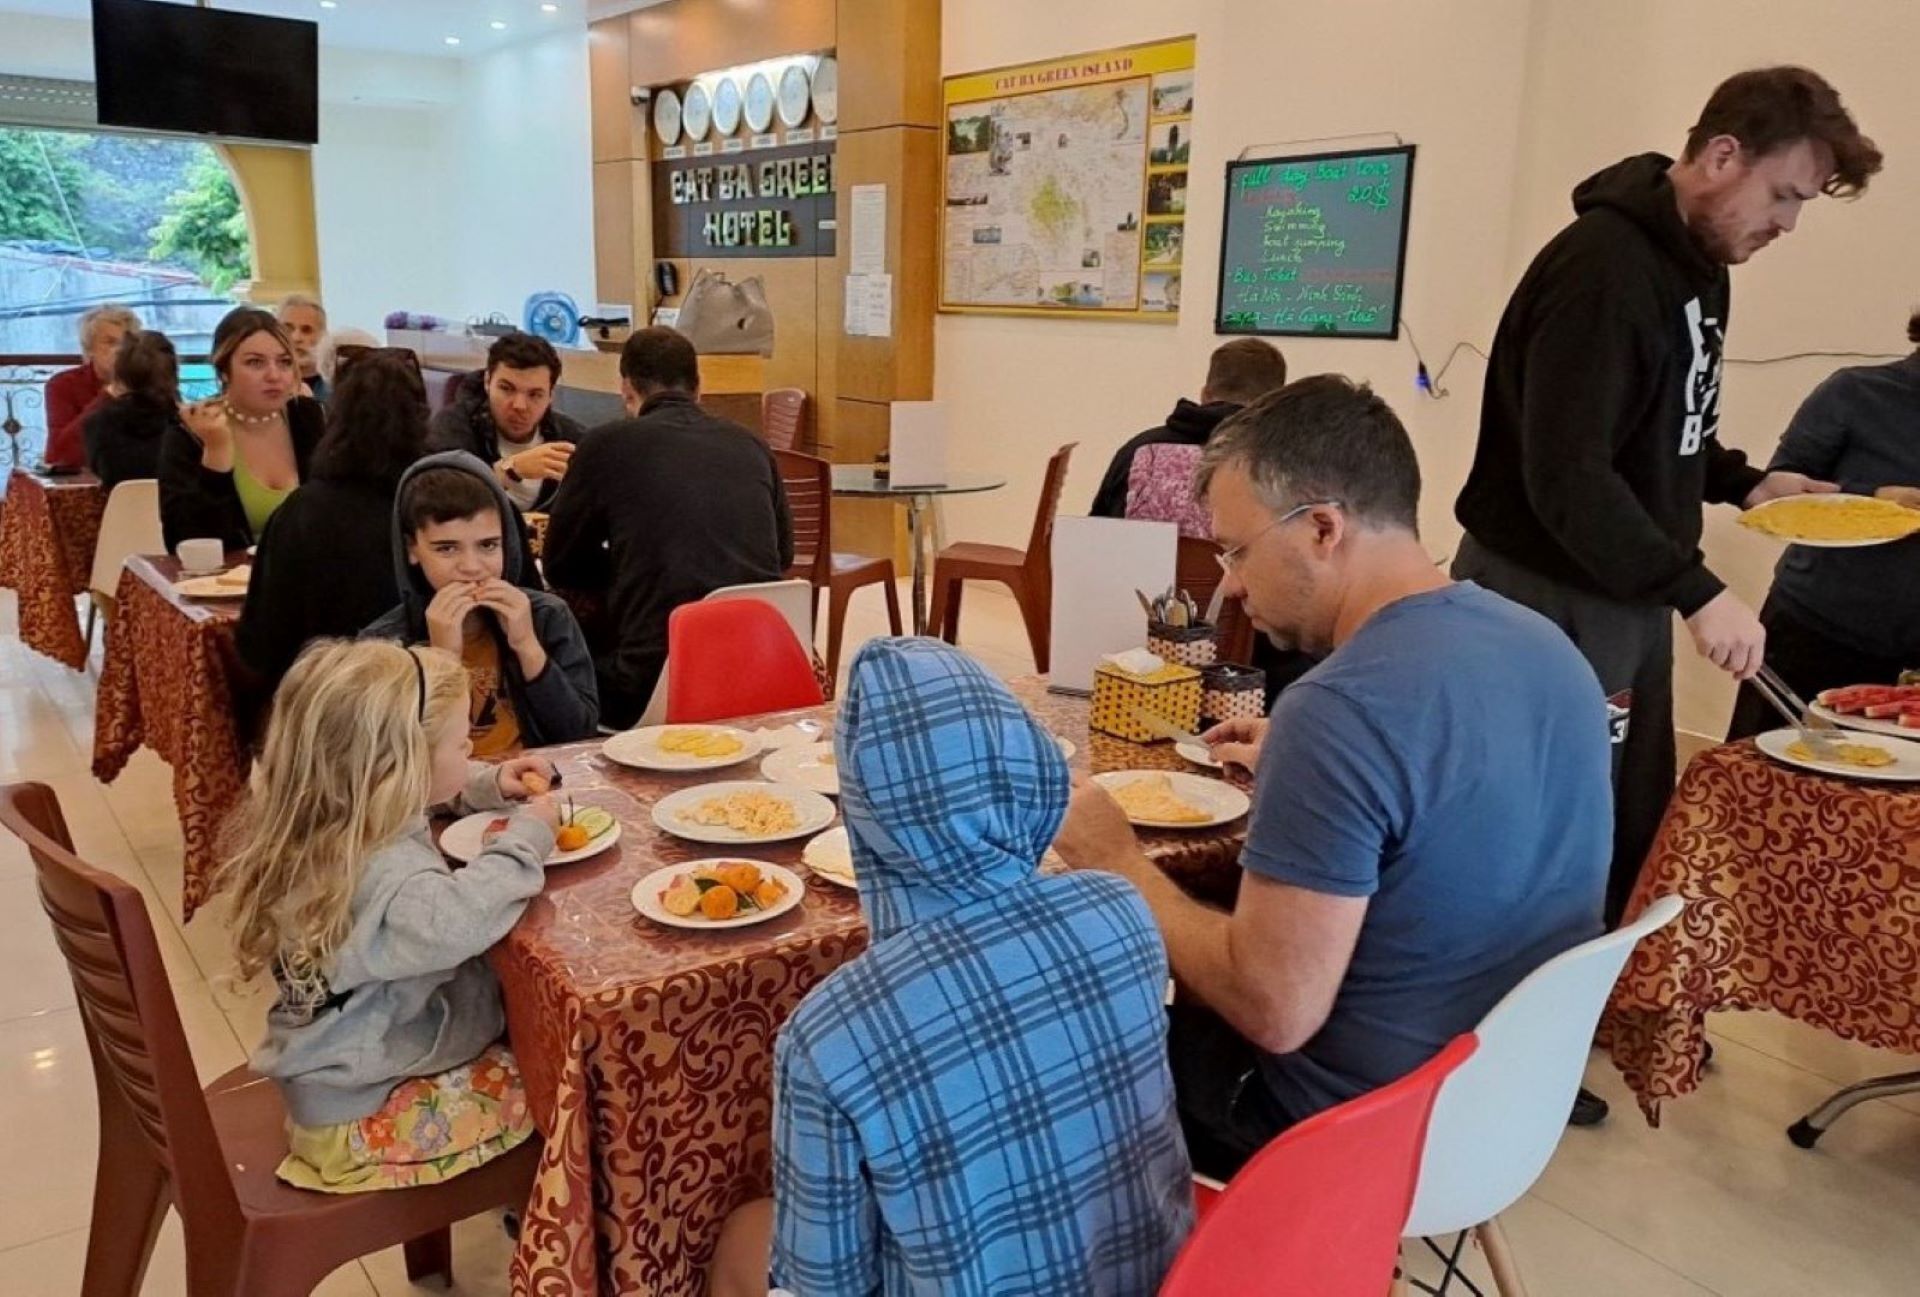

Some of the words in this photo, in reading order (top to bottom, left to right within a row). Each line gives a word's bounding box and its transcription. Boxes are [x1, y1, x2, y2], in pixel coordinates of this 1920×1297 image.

[995, 77, 1015, 90] CAT
[1019, 73, 1035, 86] BA
[1038, 67, 1077, 84] GREEN
[1082, 58, 1133, 77] ISLAND
[719, 164, 754, 200] BA
[703, 210, 791, 246] HOTEL
